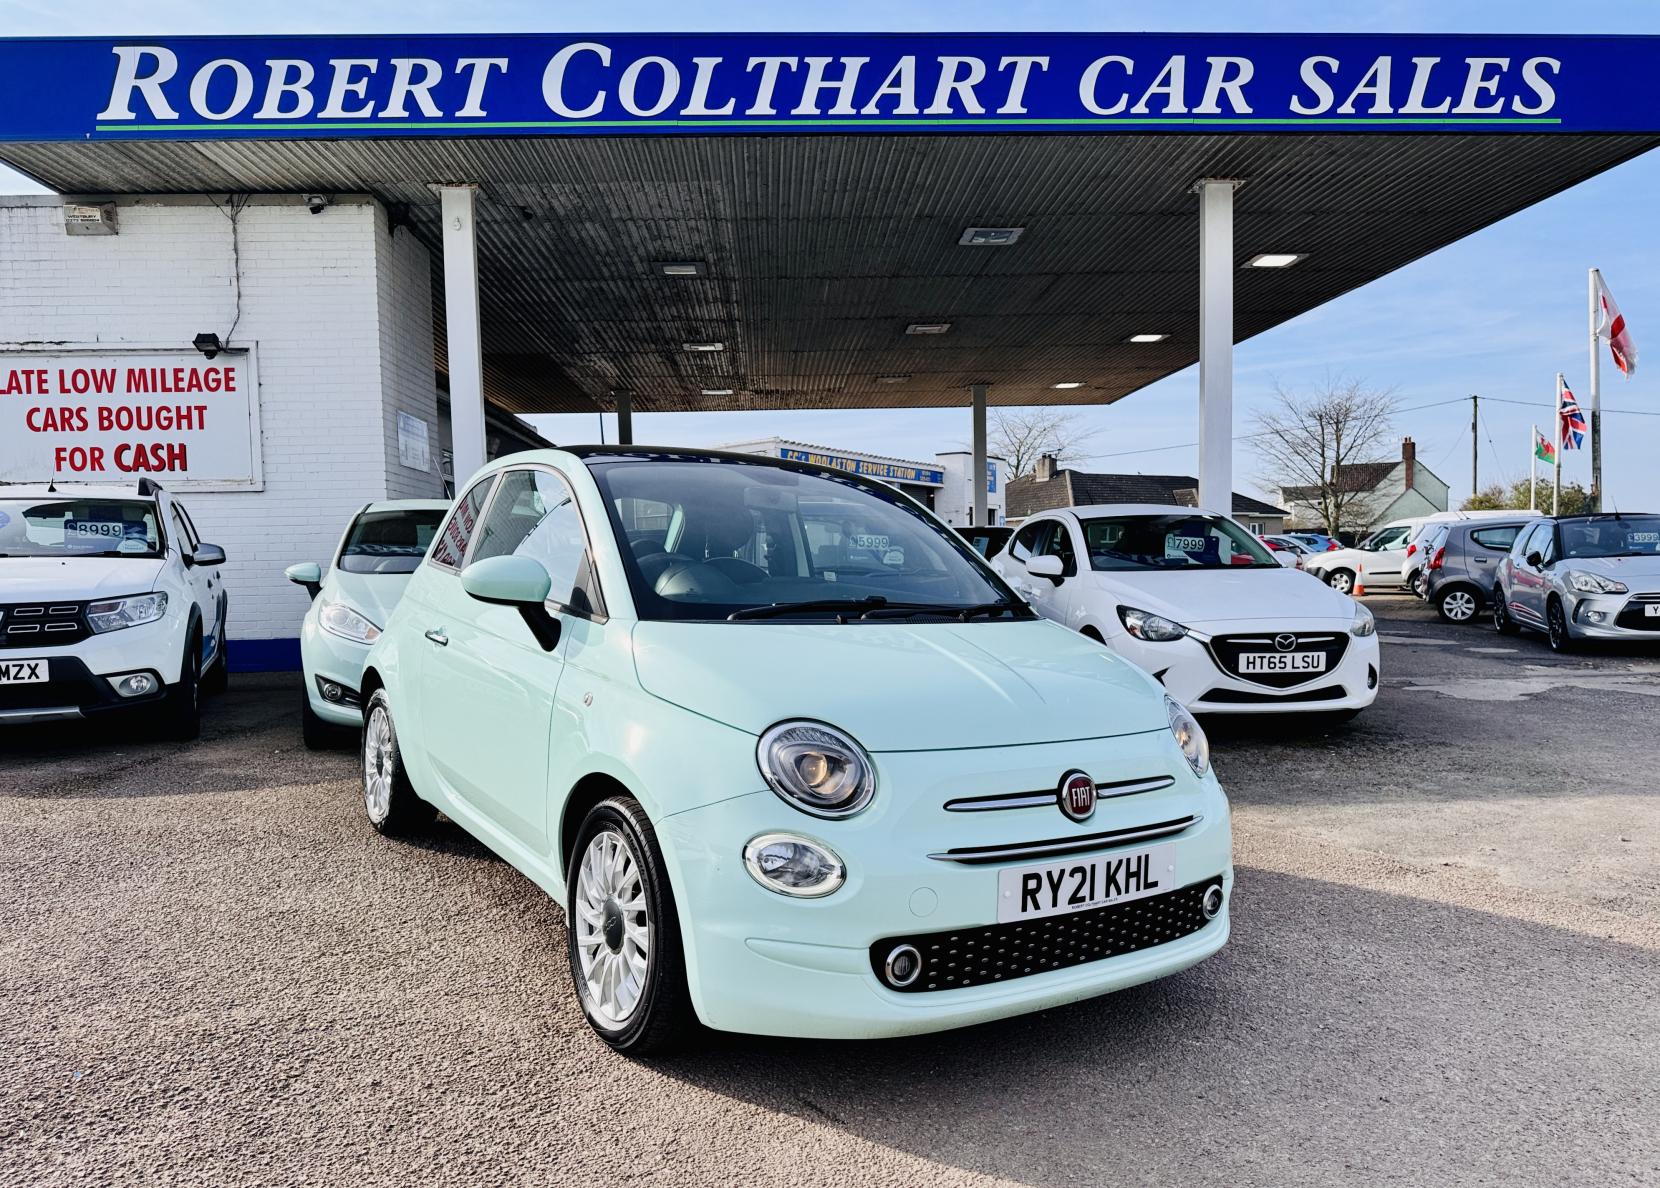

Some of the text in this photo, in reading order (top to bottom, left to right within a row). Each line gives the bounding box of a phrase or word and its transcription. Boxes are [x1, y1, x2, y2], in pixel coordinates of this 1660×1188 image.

[96, 41, 1562, 121] ROBERT COLTHART CAR SALES
[58, 368, 117, 394] LOW
[126, 367, 236, 393] MILEAGE
[26, 405, 208, 432] CARS BOUGHT
[54, 442, 188, 473] FOR CASH
[808, 454, 857, 473] WOOLASTON
[858, 461, 888, 477] SERVICE
[889, 466, 916, 480] STATION
[0, 662, 40, 681] MZX
[1246, 654, 1320, 671] HT65 LSU
[1071, 786, 1091, 808] FIAT
[1021, 853, 1159, 913] RY21 KHL
